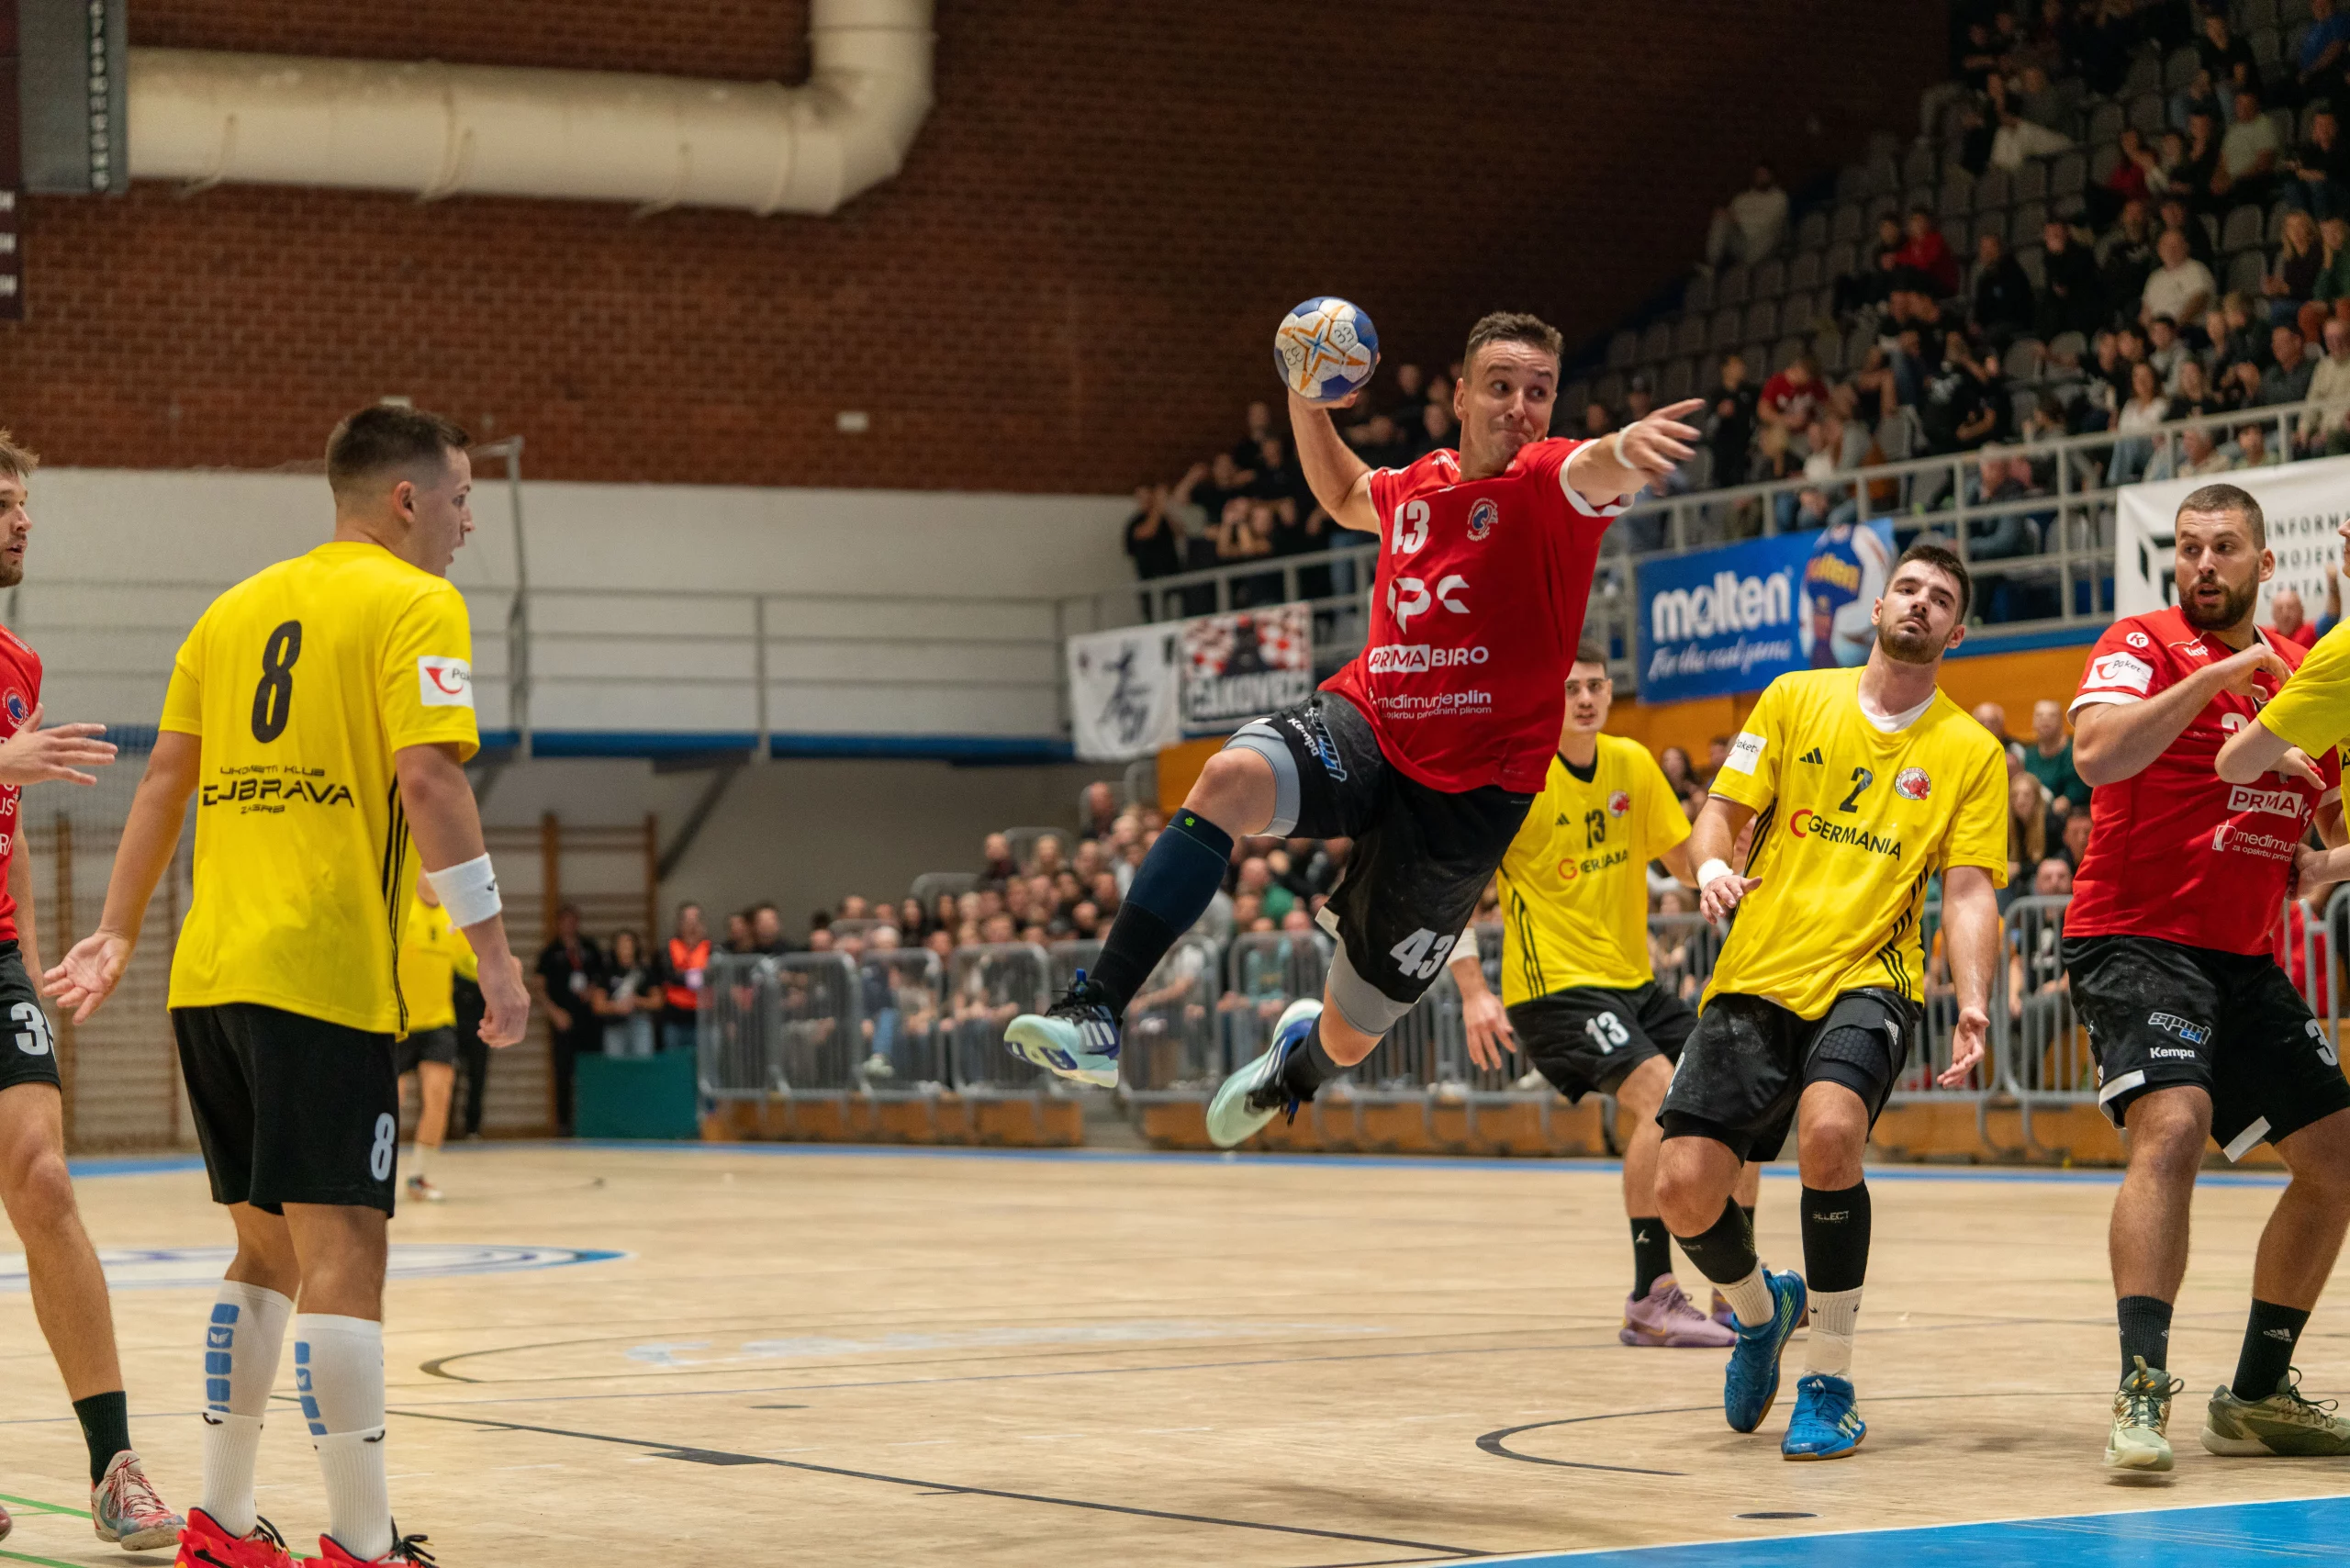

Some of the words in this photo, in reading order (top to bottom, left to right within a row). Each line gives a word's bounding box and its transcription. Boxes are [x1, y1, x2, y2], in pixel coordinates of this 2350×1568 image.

[1334, 327, 1354, 343] 33
[2265, 511, 2350, 540] INFORM
[2277, 543, 2345, 569] ROJEK
[1651, 570, 1791, 643] molten
[2263, 578, 2323, 602] CENTA
[251, 619, 303, 745] 8
[1460, 705, 1492, 715] plinom
[1839, 767, 1874, 813] 2
[1584, 809, 1606, 848] 13
[1807, 815, 1901, 861] GERMANIA
[2235, 830, 2298, 854] međimur
[2242, 846, 2272, 859] opskrbu
[1389, 927, 1456, 980] 43
[1585, 1011, 1630, 1055] 13
[2304, 1018, 2338, 1066] 3
[2149, 1047, 2196, 1059] Kempa
[371, 1112, 396, 1182] 8
